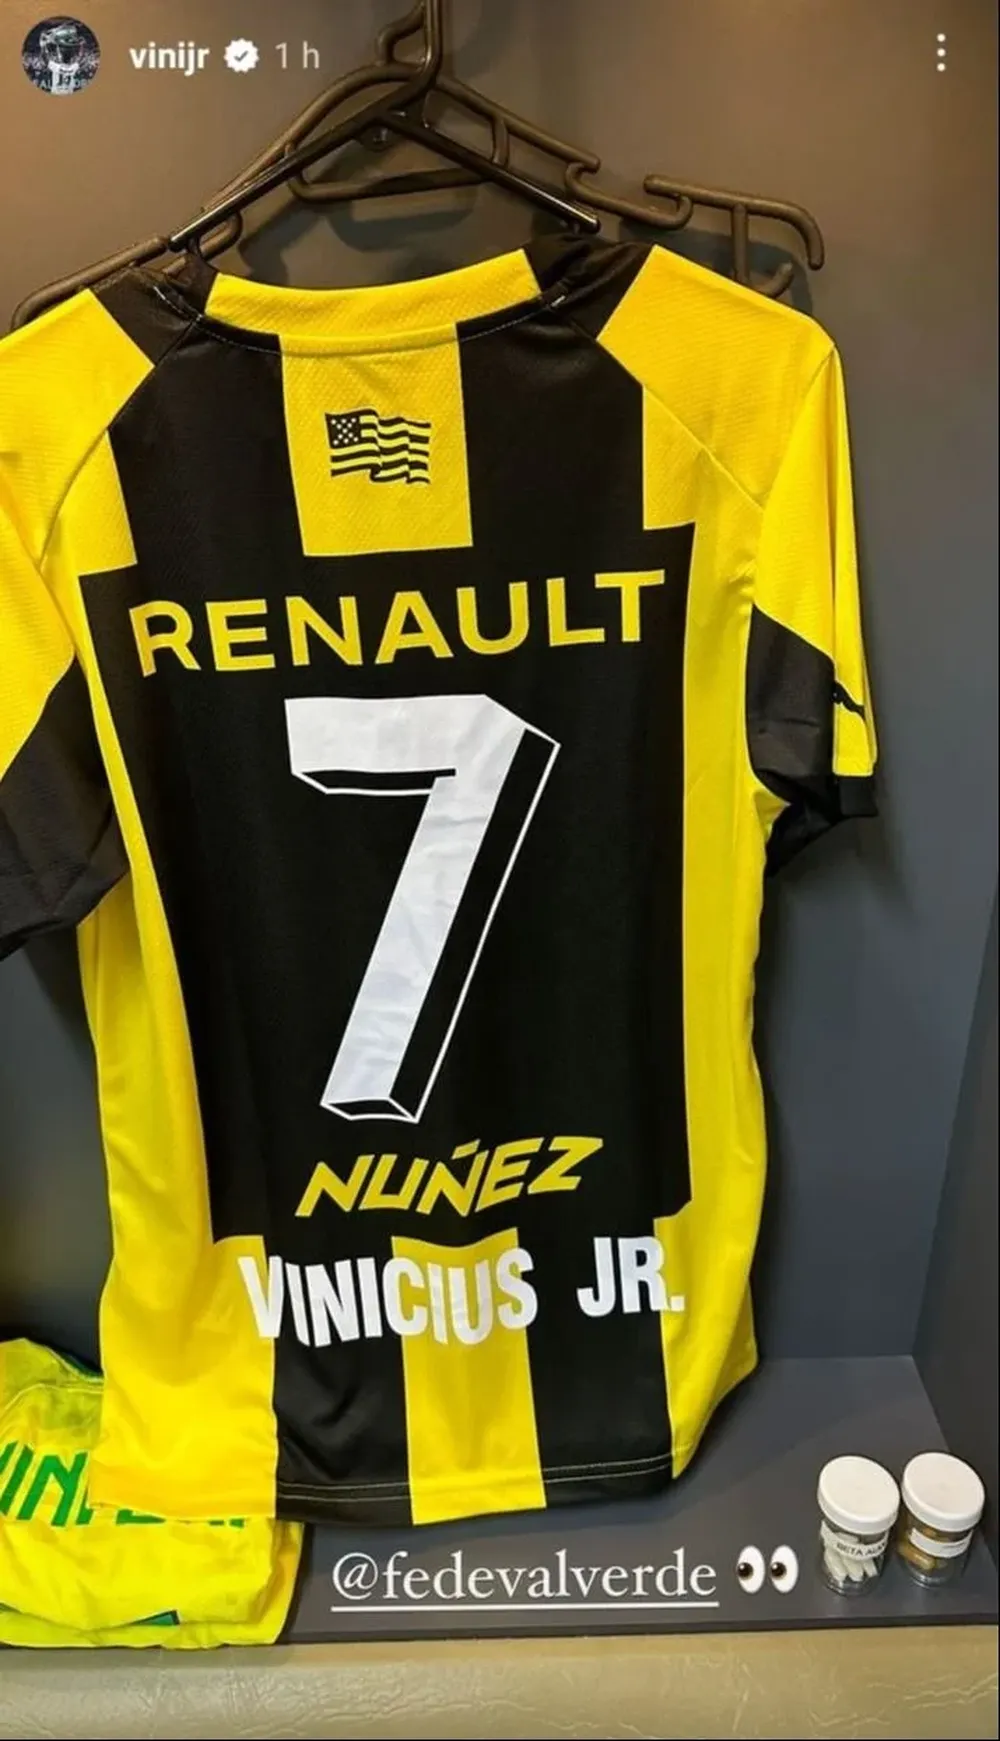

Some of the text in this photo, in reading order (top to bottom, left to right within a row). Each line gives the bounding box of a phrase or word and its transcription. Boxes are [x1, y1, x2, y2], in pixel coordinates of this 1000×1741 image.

[129, 569, 665, 677] RENAULT
[285, 694, 561, 1124] 7
[238, 1236, 685, 1347] VINICIUS JR.
